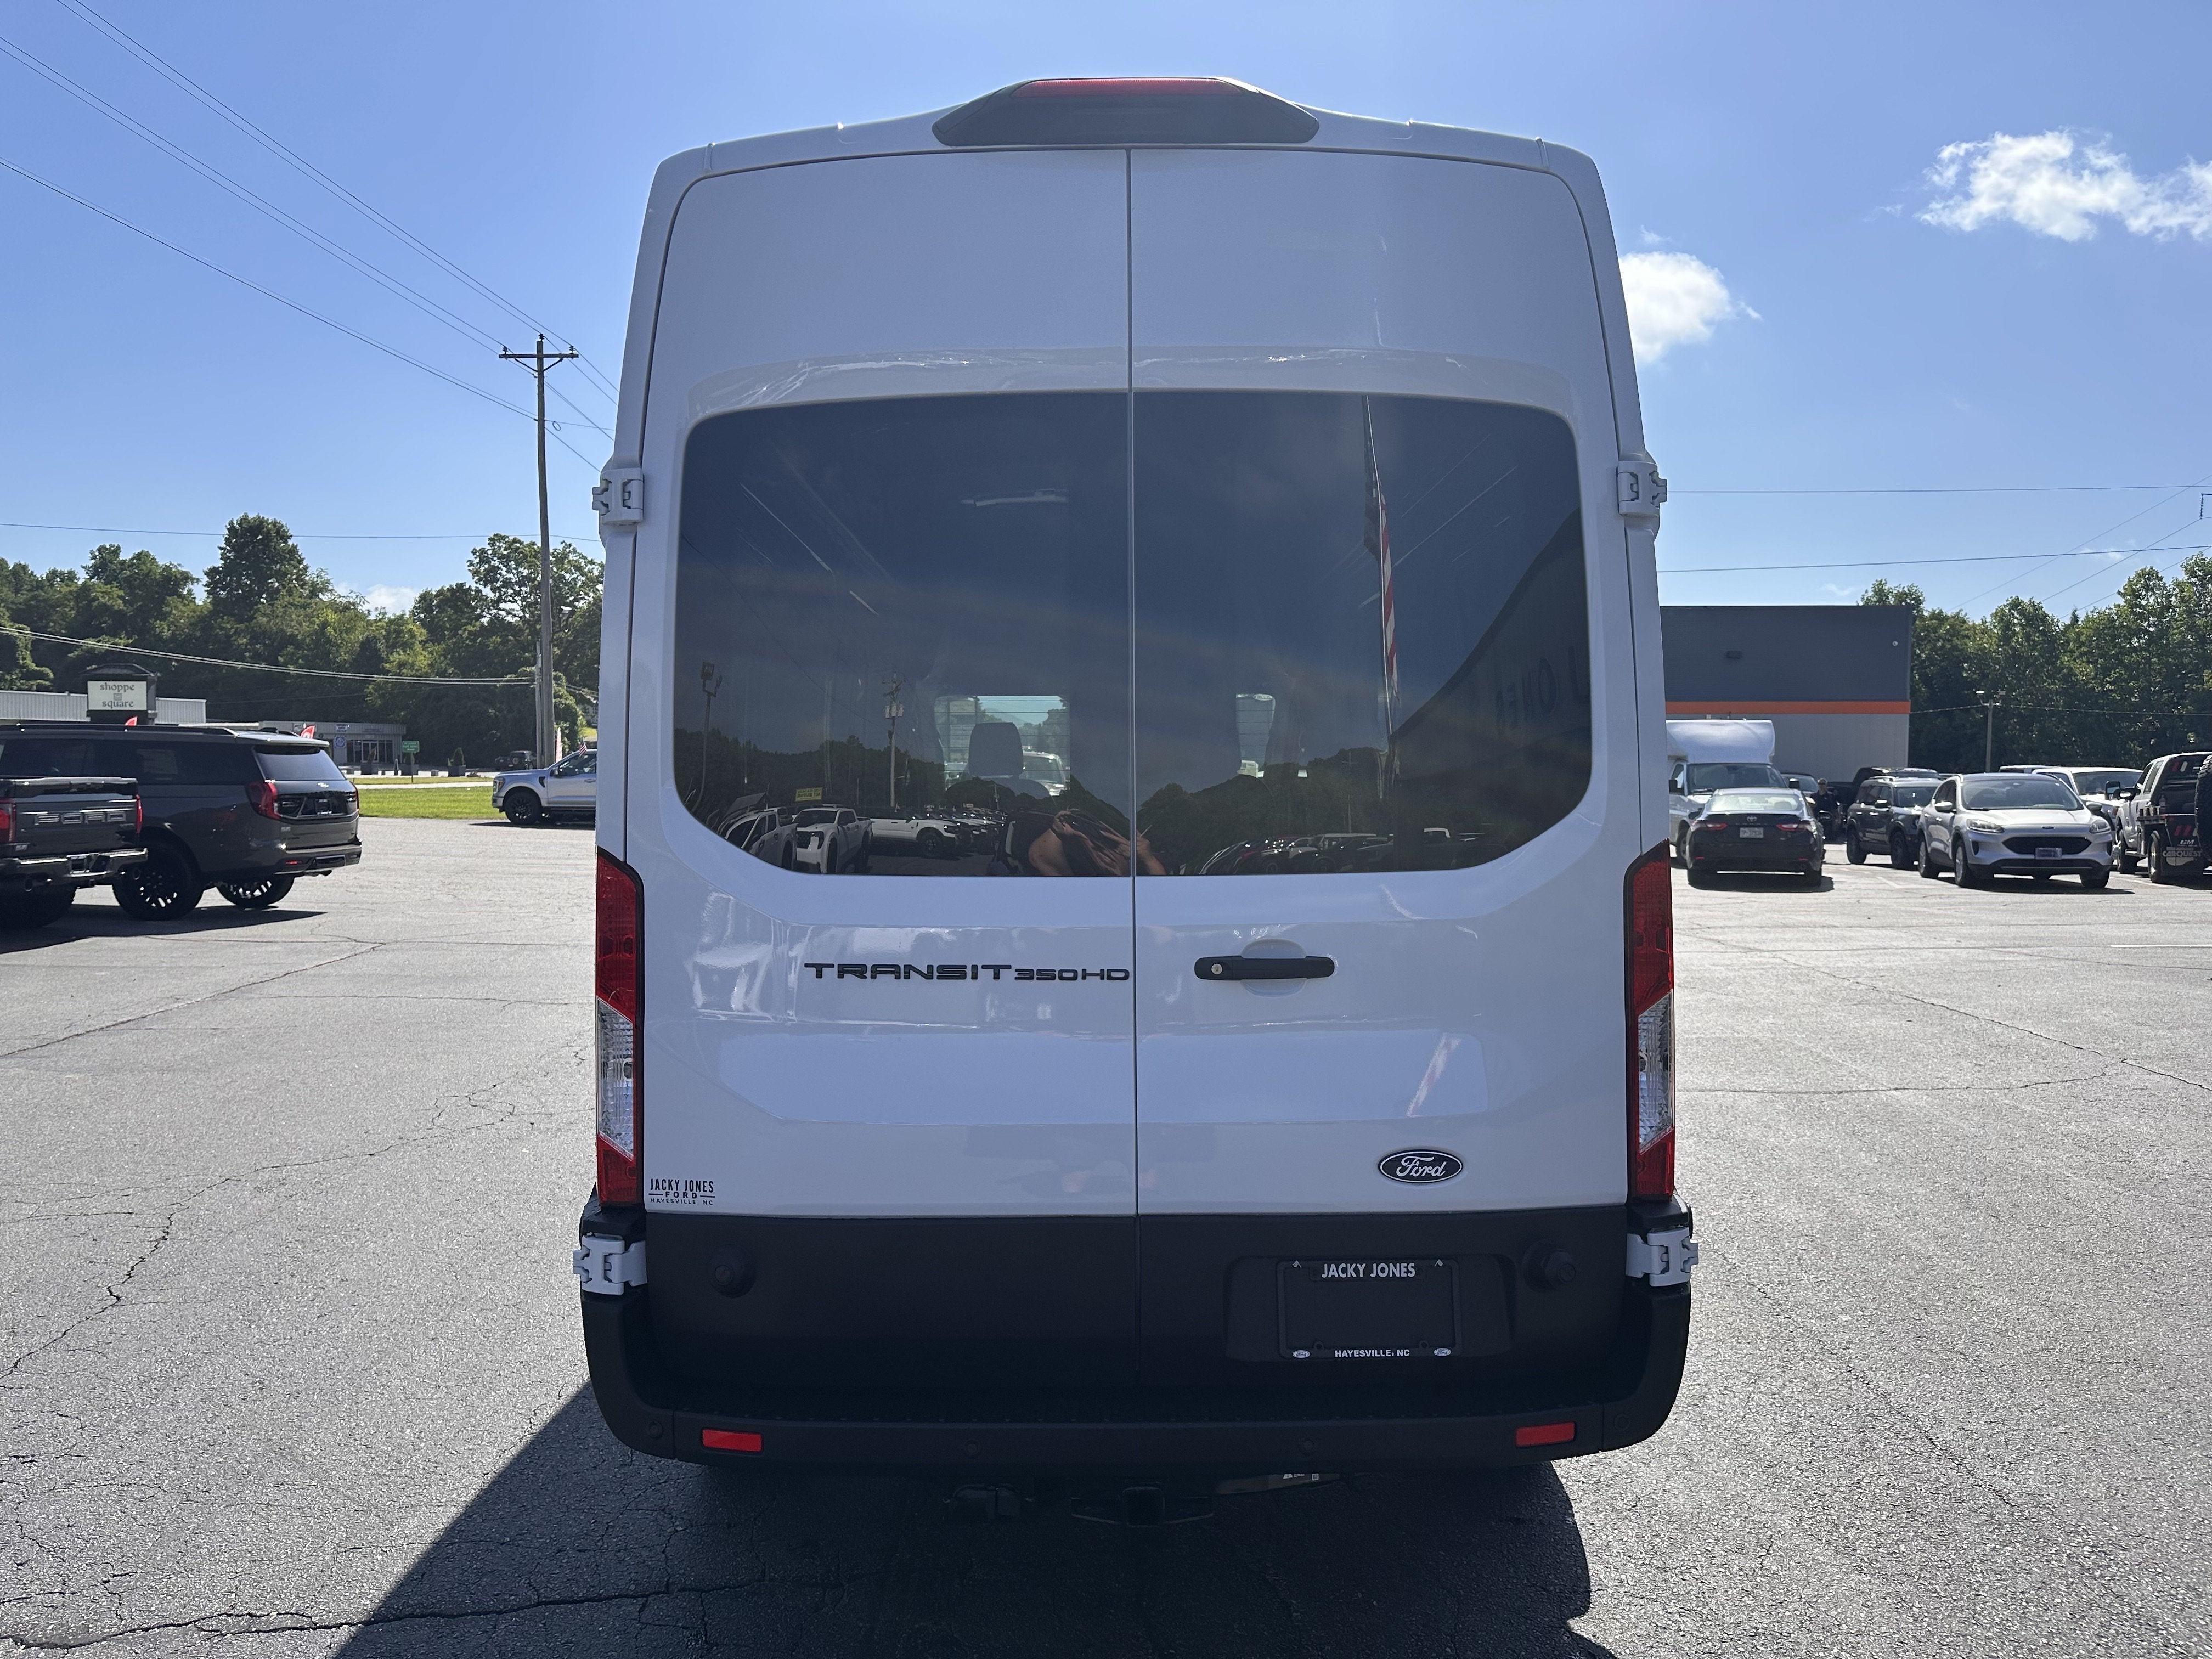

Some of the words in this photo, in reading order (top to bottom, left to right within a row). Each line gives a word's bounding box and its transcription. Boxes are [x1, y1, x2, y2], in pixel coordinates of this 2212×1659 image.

[100, 682, 134, 692] shoppe
[102, 701, 134, 709] square
[804, 963, 1012, 980] TRANSIT
[1396, 1156, 1447, 1177] Ford
[650, 1178, 680, 1191] JACKY
[685, 1180, 714, 1193] JONES
[1321, 1263, 1366, 1278] JACKY
[1370, 1262, 1416, 1278] JONES
